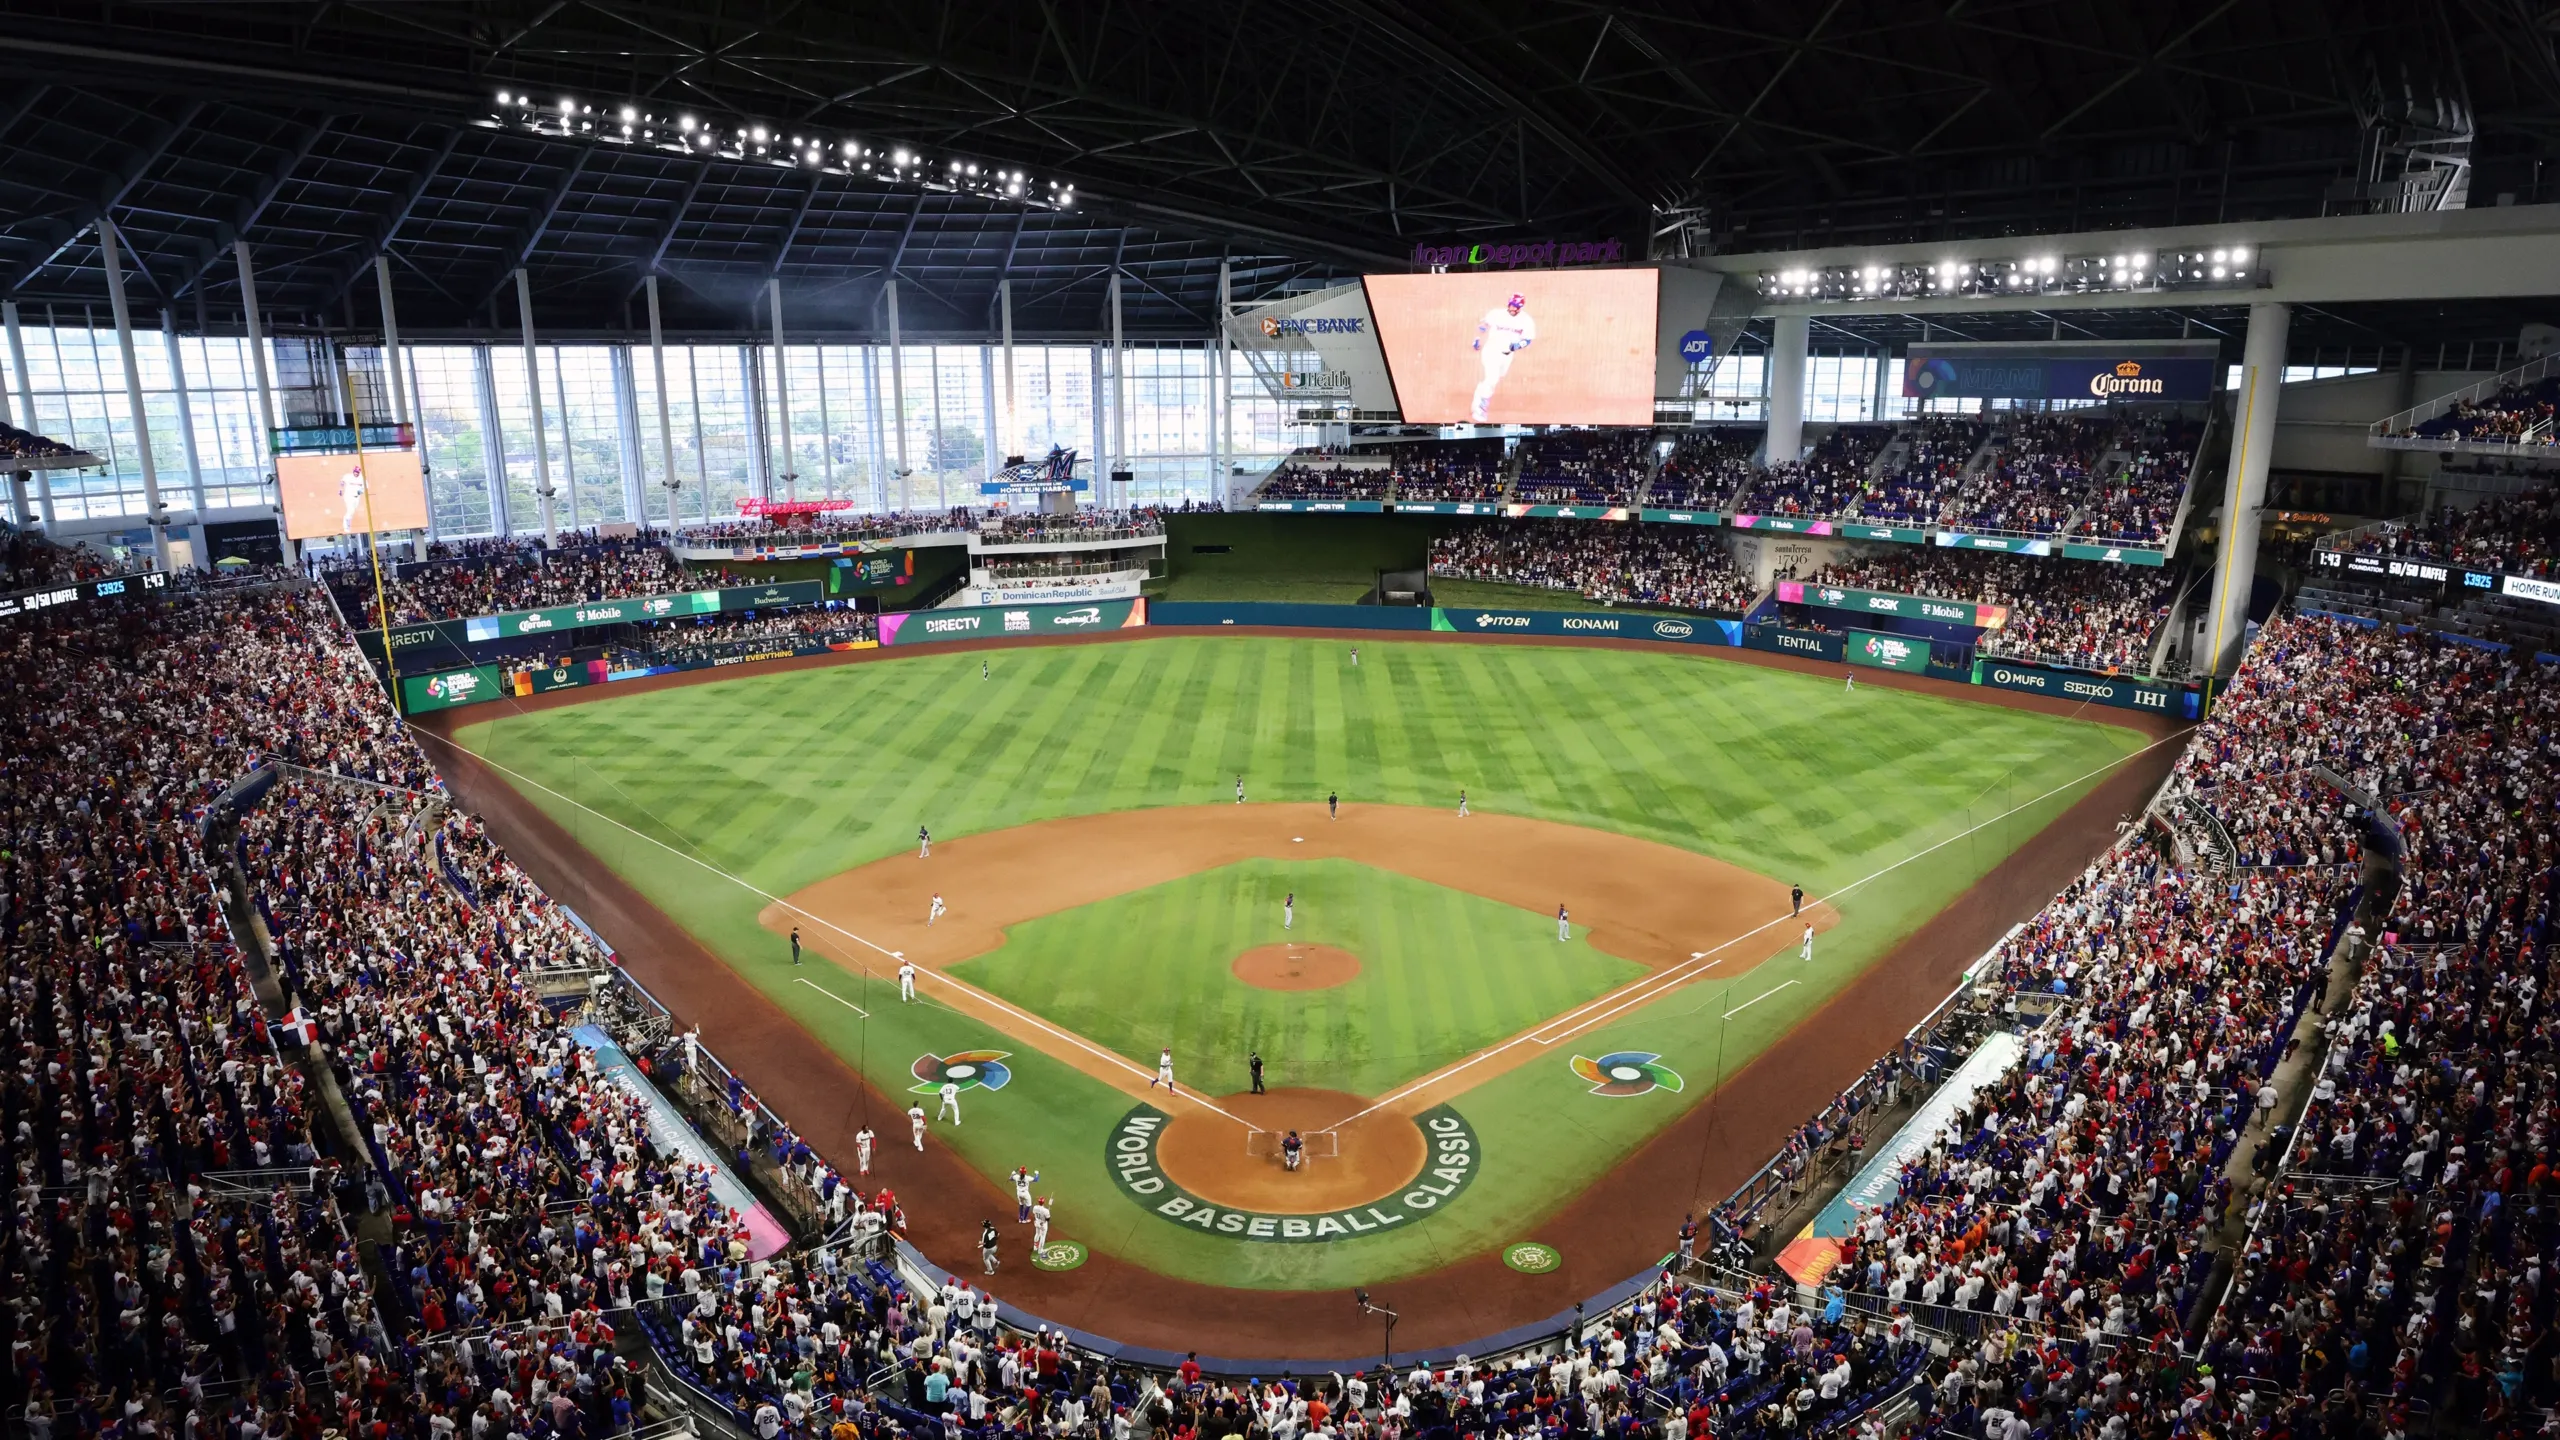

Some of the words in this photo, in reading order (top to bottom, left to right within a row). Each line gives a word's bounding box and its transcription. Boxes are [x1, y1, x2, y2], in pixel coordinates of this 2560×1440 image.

[1414, 238, 1556, 268] loanDepot
[1559, 237, 1620, 266] park
[1683, 340, 1708, 354] ADT
[1960, 367, 2042, 390] MIAMI
[2090, 372, 2163, 398] Corona
[1778, 554, 1808, 566] 1796
[2320, 552, 2341, 567] 1:43
[2355, 558, 2379, 566] MARLINS
[2348, 564, 2384, 574] FOUNDATION
[2389, 562, 2418, 576] 50/50
[2420, 566, 2448, 582] RAFFLE
[143, 573, 164, 589] 1:43
[2464, 572, 2492, 588] $3925
[97, 581, 124, 597] $3925
[2512, 582, 2542, 596] HOME
[2542, 587, 2560, 600] RUN
[24, 592, 50, 610] 50/50
[50, 588, 78, 605] RAFFLE
[754, 596, 790, 604] Budweiser
[1869, 597, 1899, 610] SCSK
[587, 608, 621, 620] Mobile
[1932, 605, 1964, 619] Mobile
[518, 619, 552, 632] Corona
[926, 617, 980, 632] DIRECTV
[1493, 616, 1513, 626] ITO
[1514, 618, 1530, 627] EN
[1563, 618, 1619, 630] KONAMI
[1656, 622, 1692, 635] Kowa
[1777, 634, 1822, 652] TENTIAL
[714, 656, 744, 666] EXPECT
[746, 650, 794, 662] EVERYTHING
[2012, 674, 2045, 687] MUFG
[2064, 682, 2114, 698] SEIKO
[2134, 690, 2168, 708] IHI
[1116, 1116, 1165, 1195] WORLD
[1157, 1197, 1404, 1237] BASEBALL
[1403, 1117, 1472, 1210] CLASSIC
[1860, 1166, 1898, 1198] WORLD
[1800, 1250, 1838, 1282] MIAMI
[945, 1293, 954, 1302] 22
[2090, 1290, 2098, 1300] 23
[1350, 1388, 1362, 1396] 22
[764, 1414, 774, 1424] 22
[862, 1420, 872, 1430] 22
